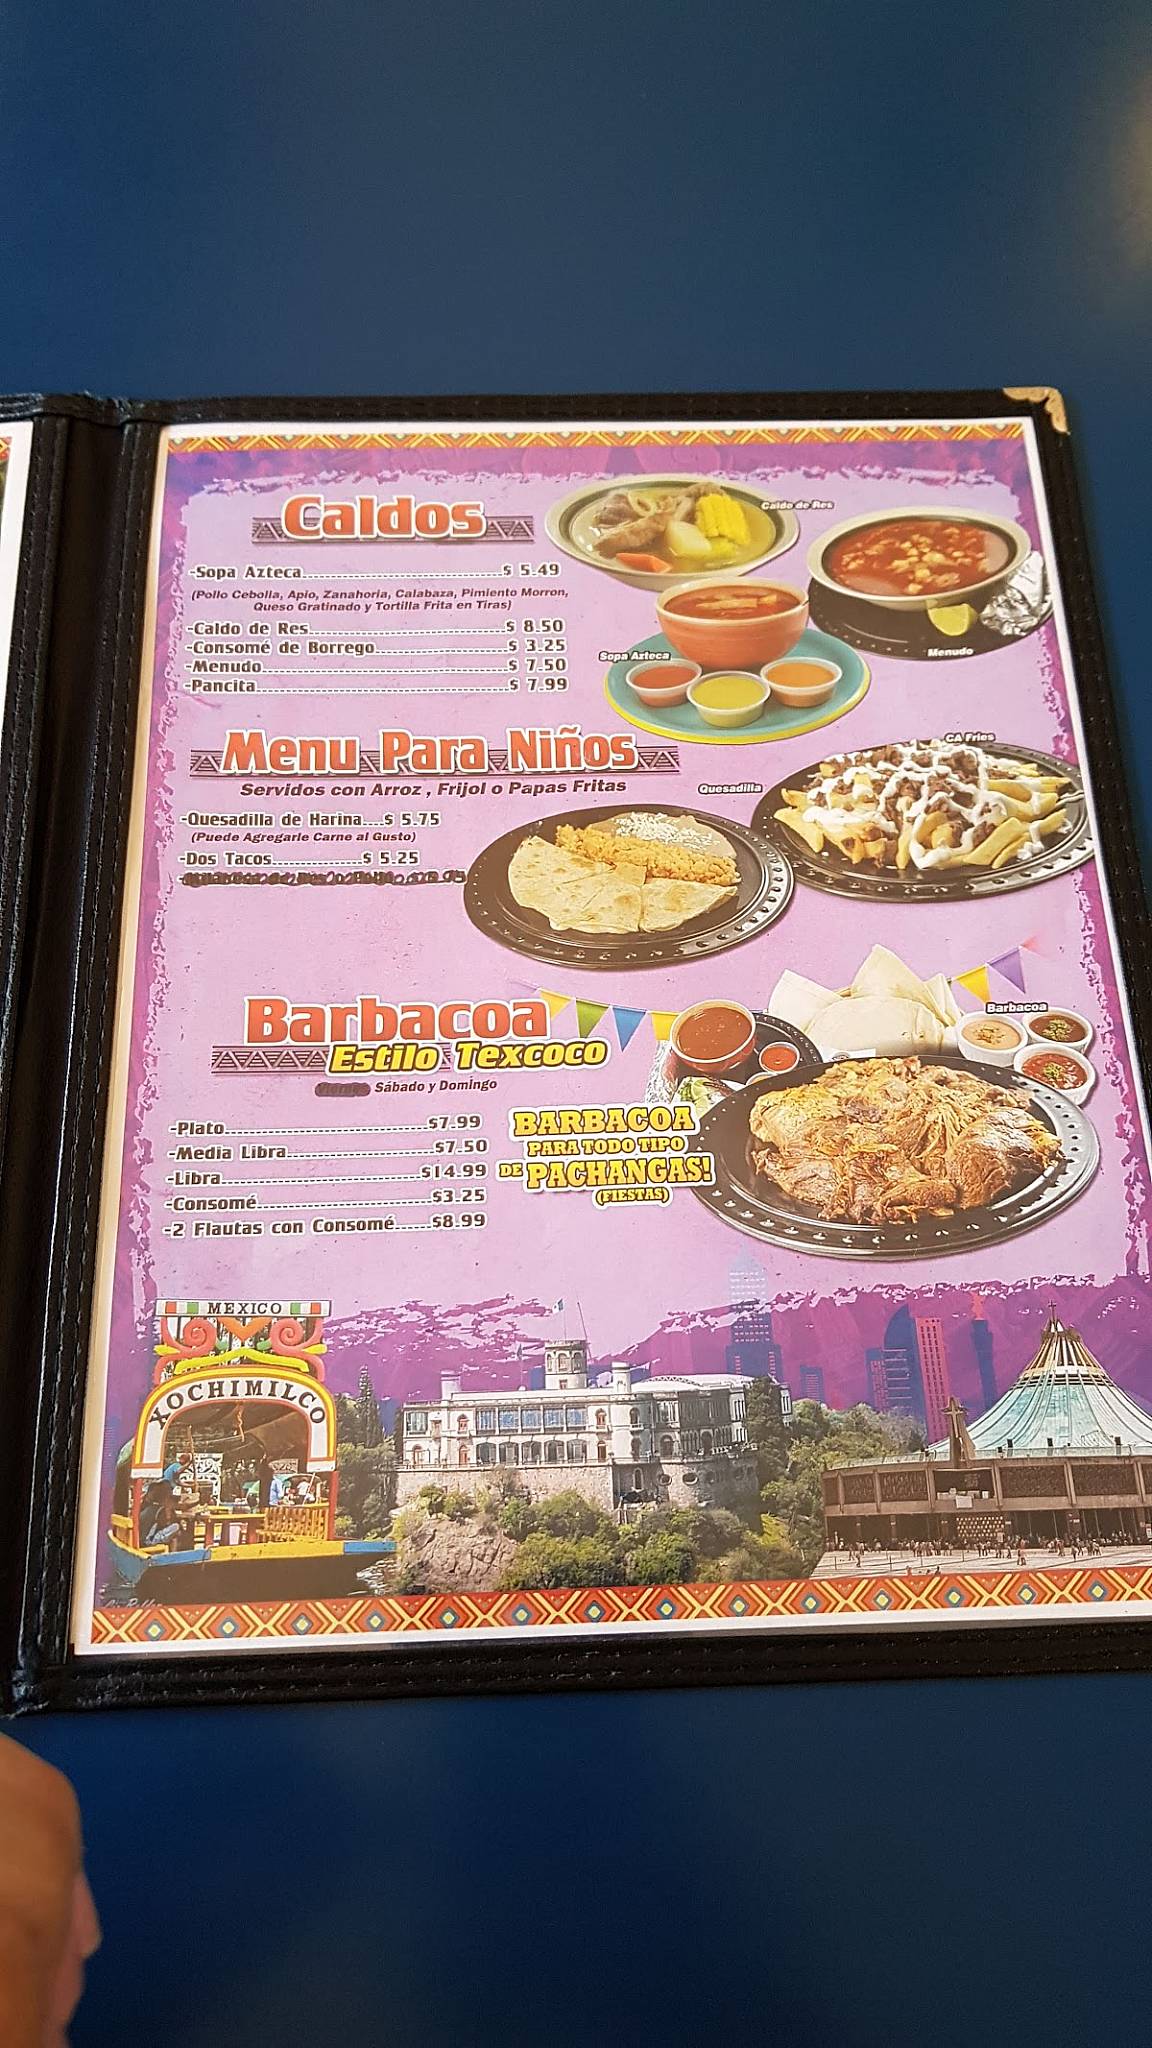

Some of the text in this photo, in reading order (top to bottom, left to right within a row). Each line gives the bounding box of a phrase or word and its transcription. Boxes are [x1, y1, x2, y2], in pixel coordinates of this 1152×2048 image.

[761, 500, 834, 510] Caldo de Res
[283, 496, 485, 539] Caldos
[245, 566, 301, 578] Azteca
[503, 564, 512, 576] $
[520, 564, 560, 575] 5.49
[191, 587, 568, 600] (Pollo Cebolla, Apio, Zanahoria, Calabaza, Pimiento Morron,
[253, 600, 512, 613] Queso Gratinado y Tortilla Frita en Tiras)
[249, 622, 269, 635] de
[278, 622, 308, 635] Res
[507, 620, 515, 632] $
[524, 620, 563, 632] 8.50
[279, 641, 299, 654] de
[308, 641, 374, 656] Borrego
[509, 640, 517, 652] $
[526, 639, 565, 651] 3.25
[927, 648, 974, 657] Menudo
[600, 651, 670, 662] Sopa Azteca
[509, 659, 517, 672] $
[527, 659, 566, 671] 7.50
[510, 679, 519, 691] $
[528, 678, 568, 690] 7.99
[945, 732, 995, 742] CA Fries
[222, 725, 638, 774] Menu Para Niños
[240, 784, 327, 796] Servidos
[331, 786, 367, 796] con
[371, 783, 422, 796] Arroz
[437, 782, 487, 797] Frijol
[491, 785, 503, 794] o
[509, 781, 568, 796] Papas
[572, 779, 627, 793] Fritas
[699, 784, 762, 793] Quesadilla
[282, 813, 301, 826] de
[310, 813, 363, 826] Harina
[384, 813, 393, 826] $
[402, 812, 440, 826] 5.75
[191, 831, 416, 844] (Puede Agregarle Carne al Gusto)
[225, 852, 272, 866] Tacos
[363, 851, 372, 865] $
[381, 851, 418, 864] 5.25
[986, 1002, 1048, 1013] Barbacoa
[246, 998, 548, 1043] Barbacoa
[330, 1040, 607, 1074] Estilo Texcoco
[375, 1078, 426, 1093] Sábado
[429, 1081, 437, 1094] y
[439, 1077, 497, 1093] Domingo
[428, 1115, 481, 1131] $7.99
[514, 1107, 695, 1136] BARBACOA
[240, 1144, 286, 1159] Libra
[435, 1139, 488, 1155] $7.50
[528, 1136, 685, 1156] PARA TODO TIPO
[421, 1164, 487, 1180] $14.99
[500, 1157, 713, 1188] DE PACHANGAS!
[432, 1189, 485, 1205] $3.25
[595, 1187, 669, 1205] (FIESTAS)
[194, 1220, 262, 1236] Flautas
[270, 1221, 304, 1234] con
[312, 1215, 395, 1234] Consomé
[432, 1213, 486, 1229] $8.99
[208, 1302, 282, 1315] MEXICO
[148, 1378, 327, 1430] XOCHIMILCO
